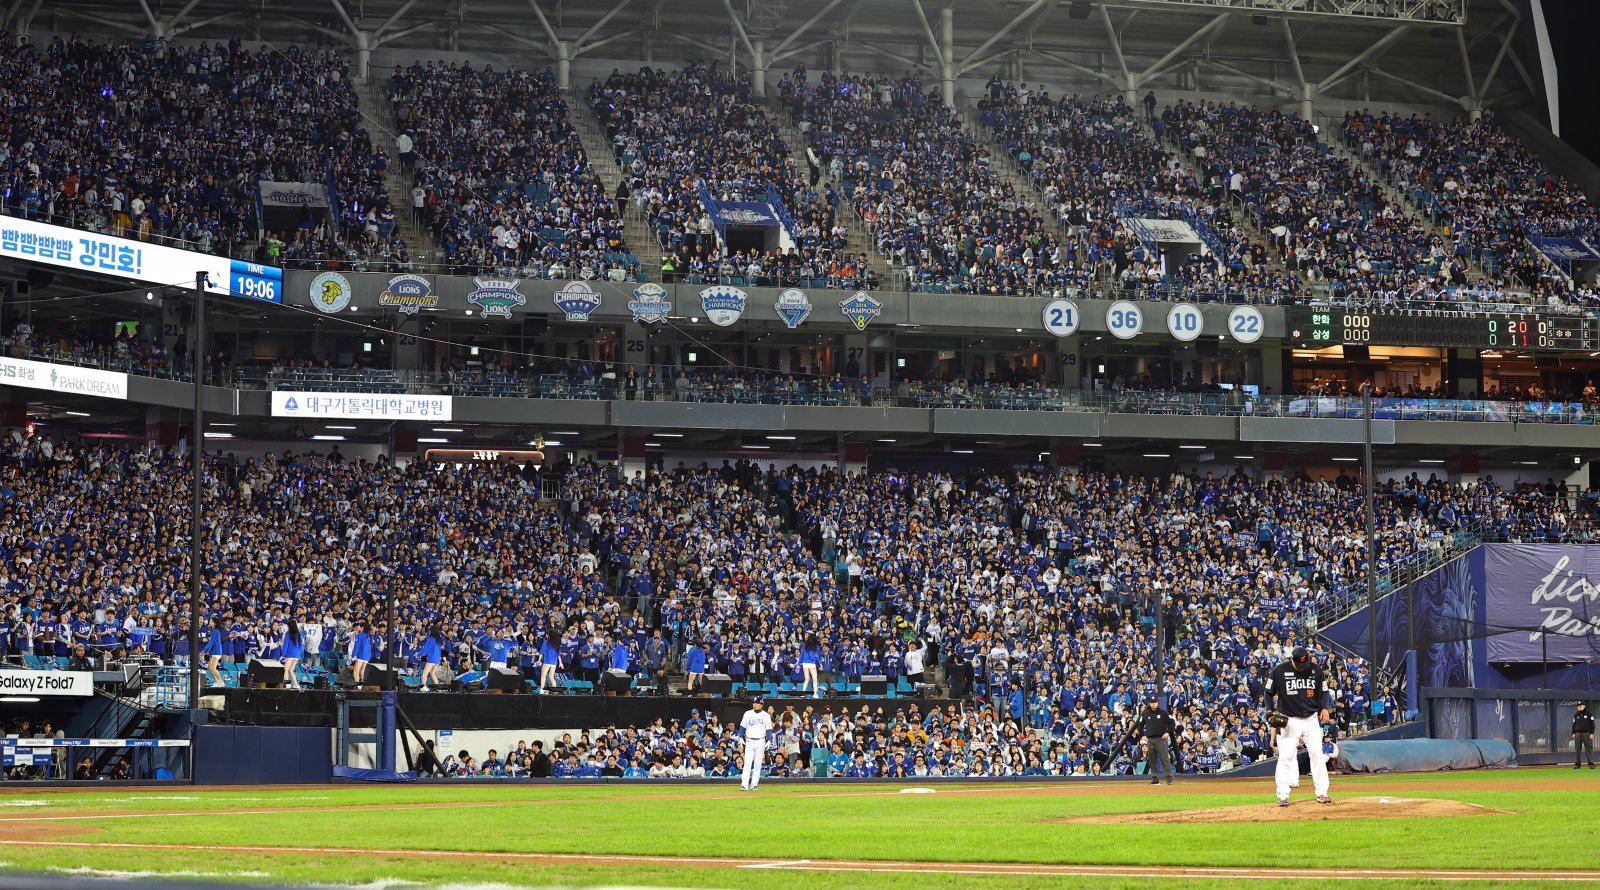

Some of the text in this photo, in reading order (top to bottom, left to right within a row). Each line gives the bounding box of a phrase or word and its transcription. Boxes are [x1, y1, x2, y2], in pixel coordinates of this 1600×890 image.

[79, 239, 142, 274] 강민호!
[246, 263, 265, 275] TIME
[238, 276, 274, 299] 19:06
[399, 285, 420, 294] LIONS
[380, 291, 438, 306] Champions
[469, 291, 524, 304] CHAMPIONS
[555, 292, 600, 305] CHAMPIONS
[485, 304, 508, 314] LIONS
[703, 301, 745, 310] CHAMPIONS
[842, 308, 881, 316] CHAMPIONS
[568, 312, 587, 320] LIONS
[787, 310, 801, 328] 7
[857, 315, 865, 328] 8
[1050, 309, 1073, 327] 21
[1111, 310, 1138, 329] 36
[1452, 311, 1459, 319] 13
[1174, 313, 1197, 331] 10
[1233, 315, 1259, 333] 22
[1312, 314, 1330, 325] 한화
[1489, 320, 1496, 333] 0
[1508, 321, 1517, 333] 2
[1519, 321, 1527, 333] 0
[1538, 322, 1546, 334] 0
[164, 324, 178, 337] 21
[1312, 329, 1330, 340] 삼성
[1489, 333, 1497, 345] 0
[1511, 334, 1517, 346] 1
[1523, 335, 1527, 346] 1
[1539, 335, 1547, 347] 0
[627, 340, 644, 352] 25
[1062, 353, 1077, 365] 29
[18, 367, 35, 380] 화성
[306, 397, 443, 416] 대구가톨릭대학교병원
[37, 676, 43, 689] Z
[45, 676, 74, 690] Fold7
[1286, 679, 1316, 691] EAGLES
